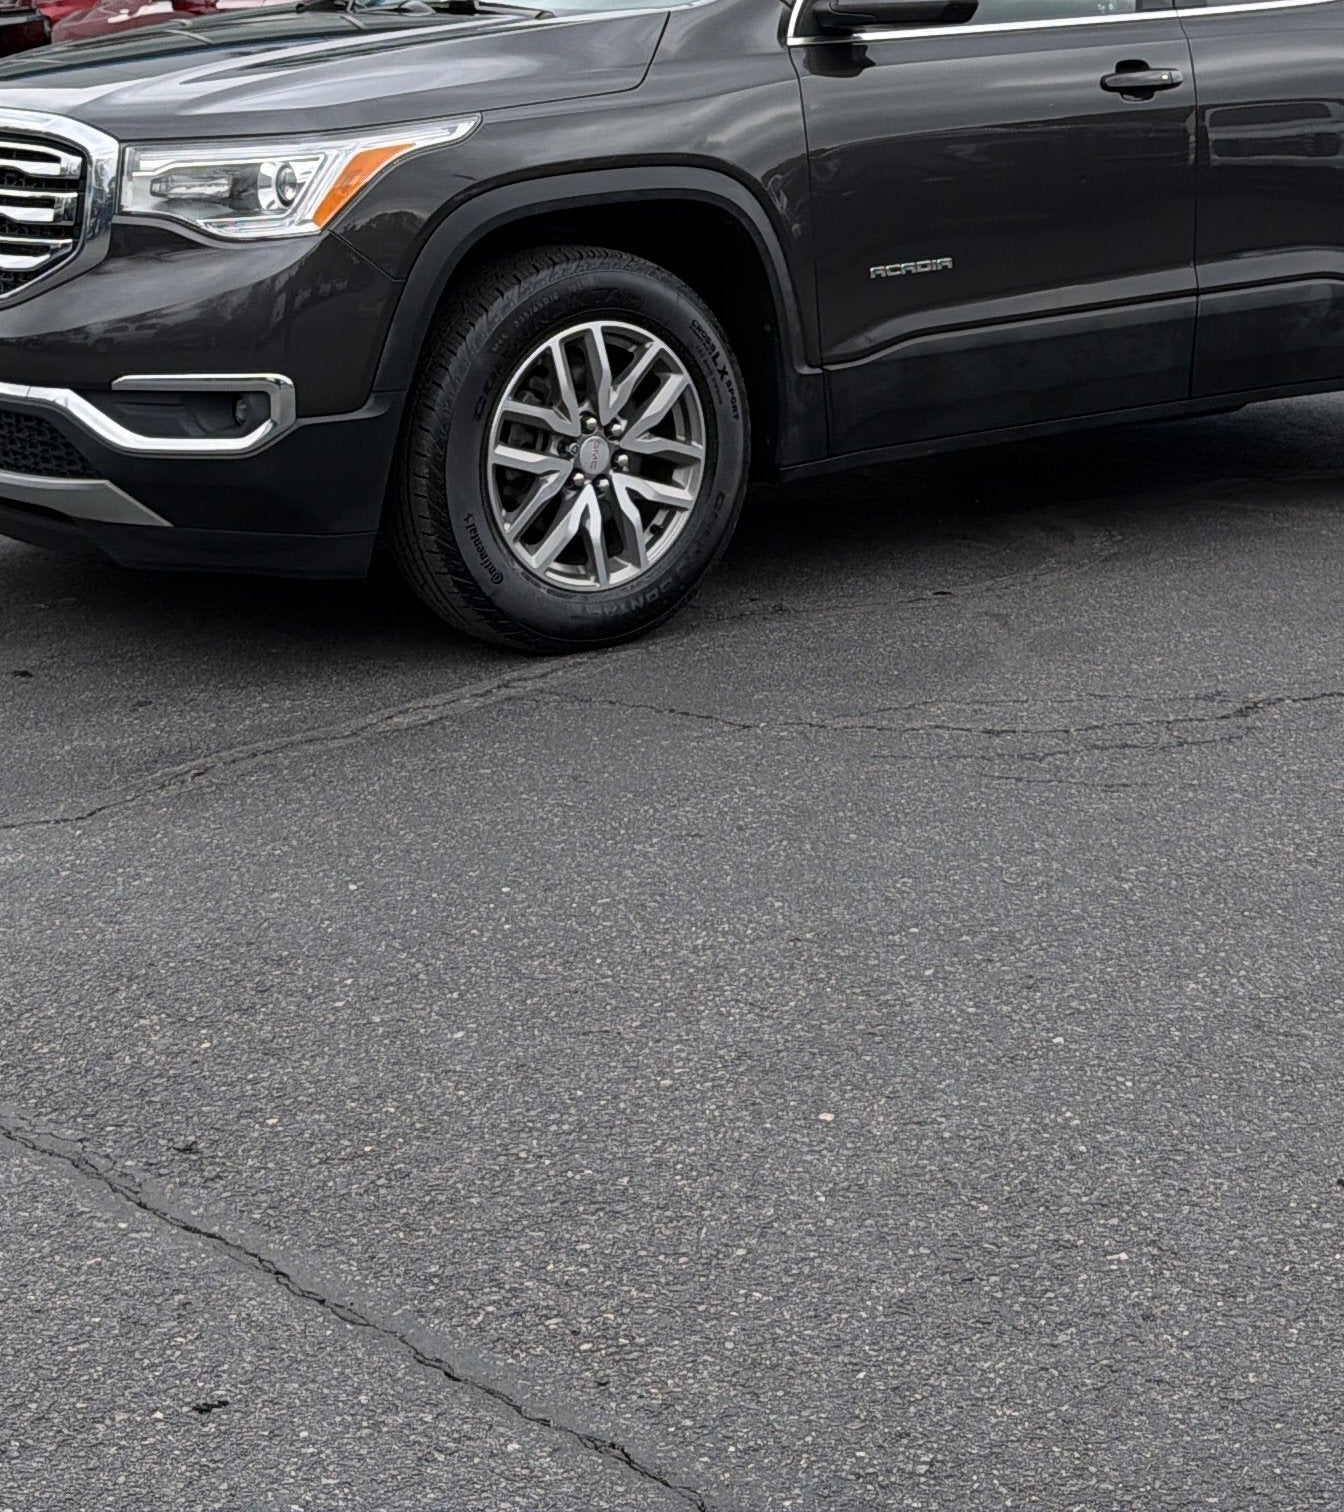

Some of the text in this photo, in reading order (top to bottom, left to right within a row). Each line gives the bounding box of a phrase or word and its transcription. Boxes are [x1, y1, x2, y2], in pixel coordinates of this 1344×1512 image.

[869, 256, 953, 280] ACADIA
[725, 379, 740, 421] SPORT
[465, 522, 504, 585] Continental
